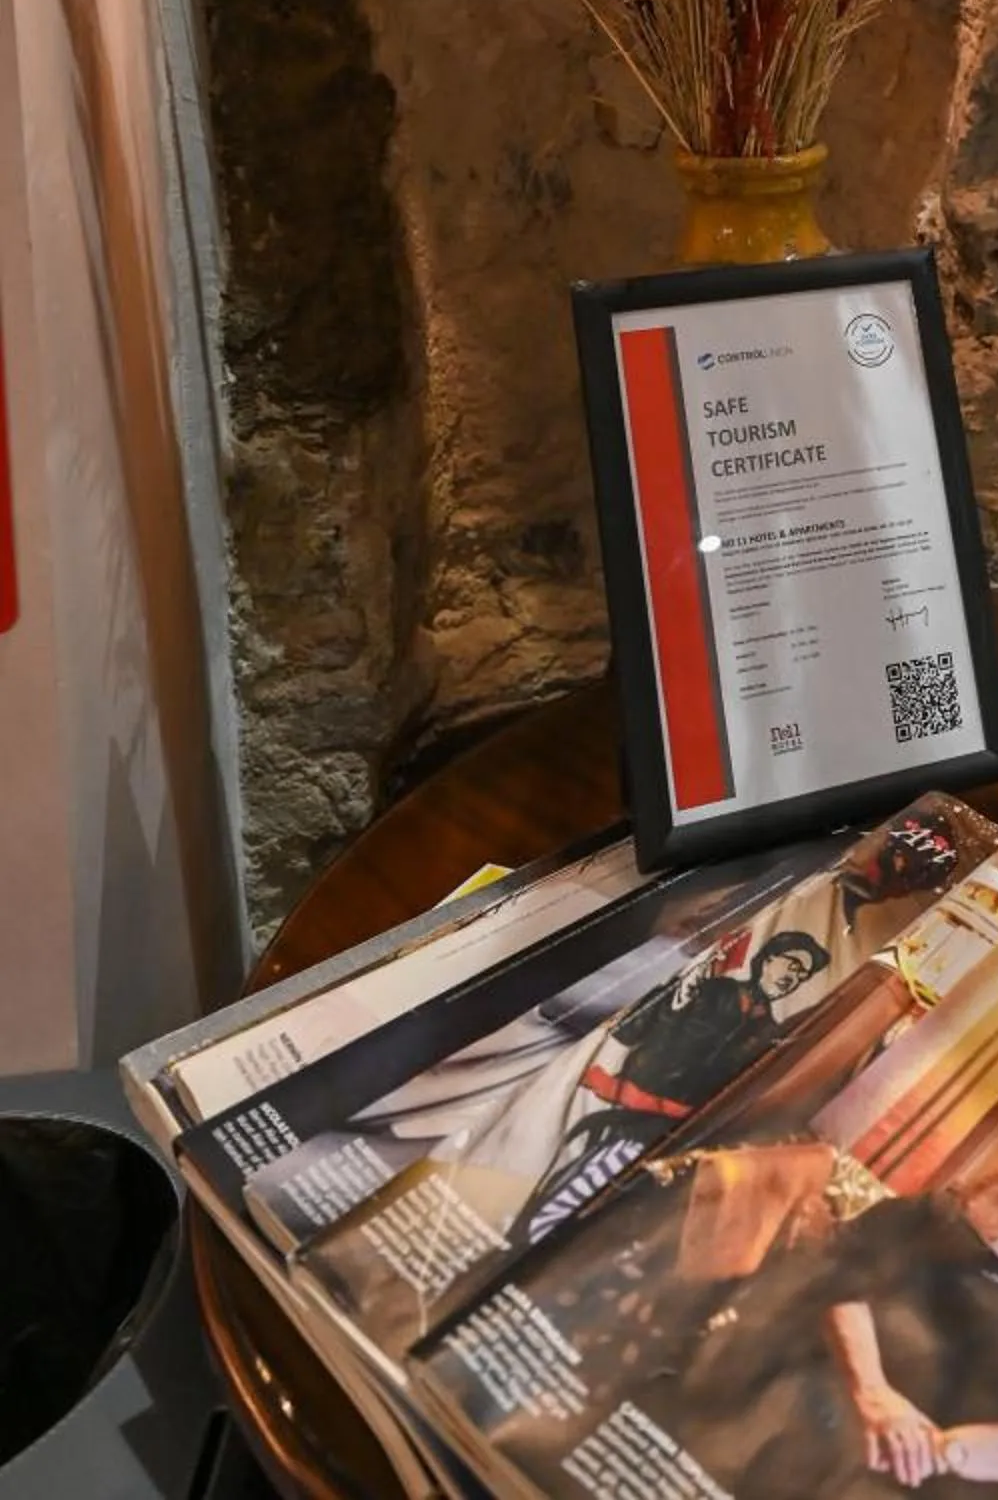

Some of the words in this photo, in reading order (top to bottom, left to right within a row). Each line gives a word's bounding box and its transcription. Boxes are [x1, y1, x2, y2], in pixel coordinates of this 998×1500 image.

[703, 396, 749, 419] SAFE
[707, 419, 797, 448] TOURISM
[711, 445, 827, 477] CERTIFICATE
[888, 829, 957, 863] Art
